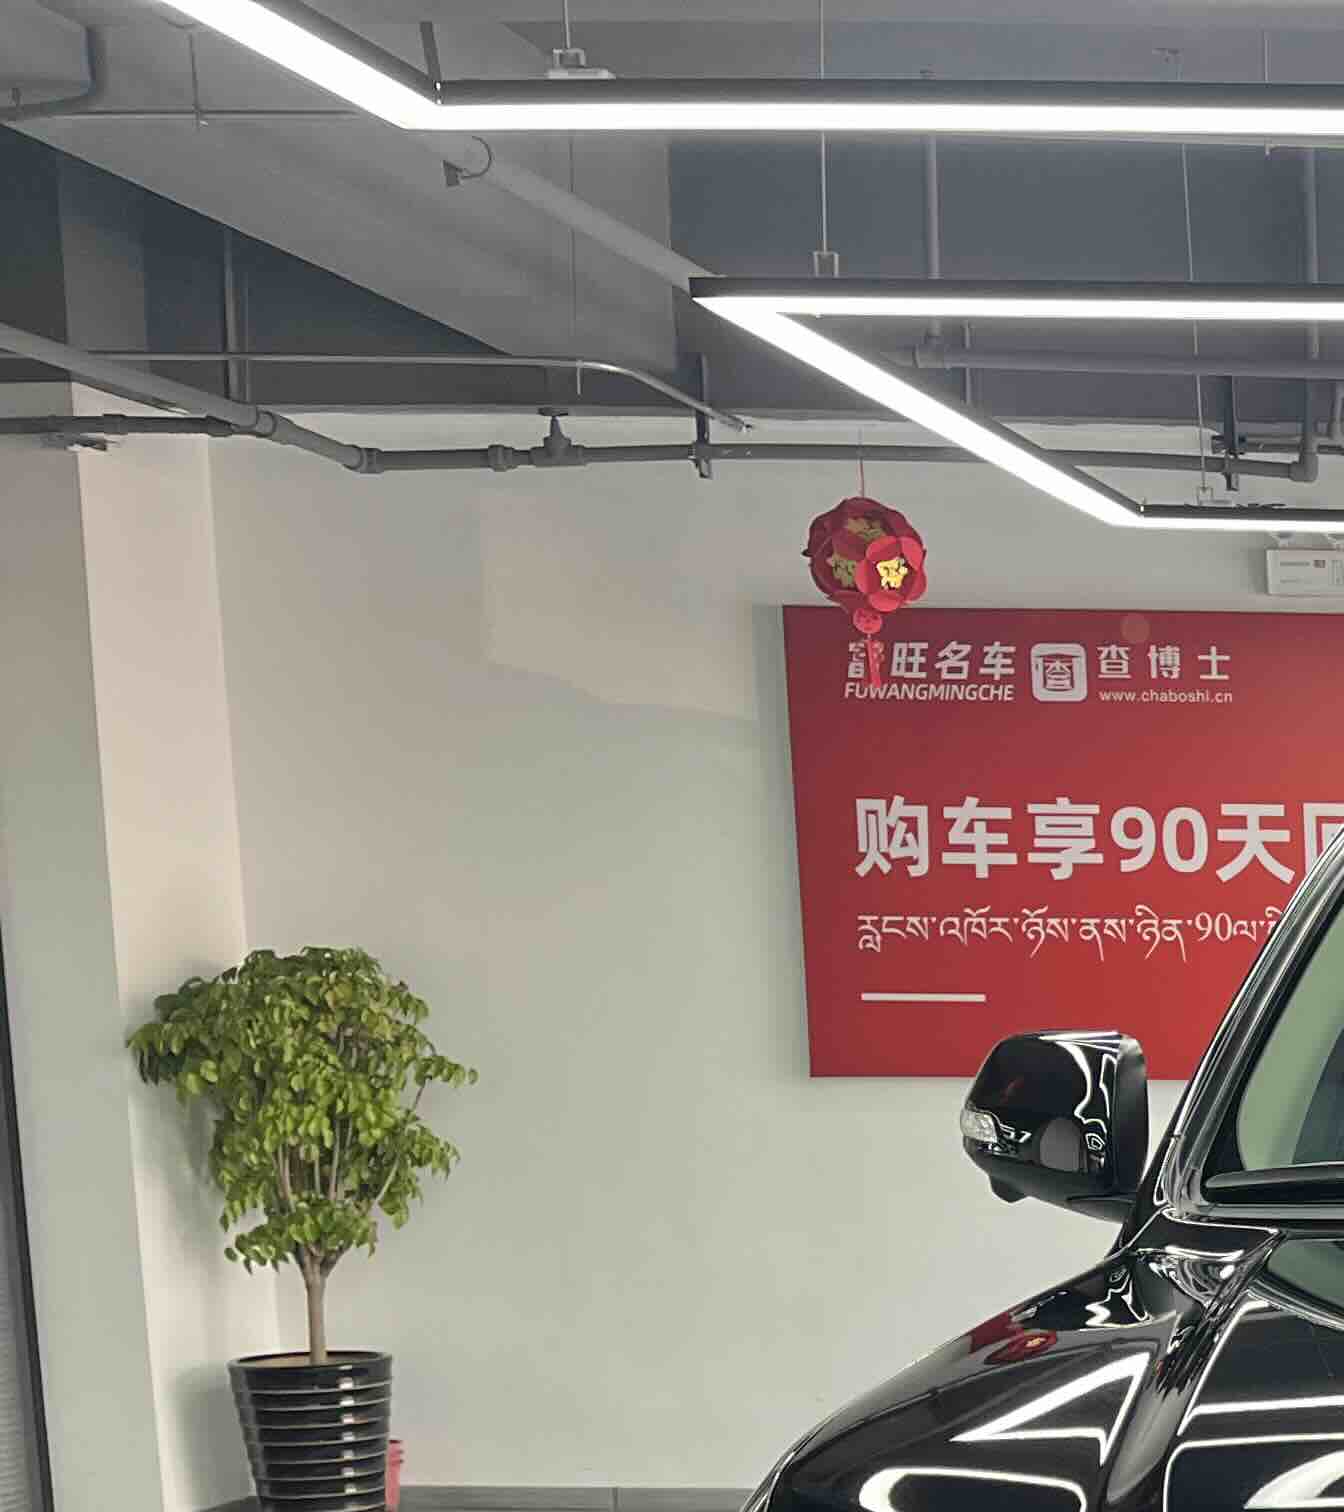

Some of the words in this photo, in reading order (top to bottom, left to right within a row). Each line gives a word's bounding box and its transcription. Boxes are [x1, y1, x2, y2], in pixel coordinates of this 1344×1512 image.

[1097, 645, 1231, 680] 查博士
[845, 682, 1014, 701] FUWANGMINGCHE
[1100, 689, 1232, 703] www.chaboshi.cn
